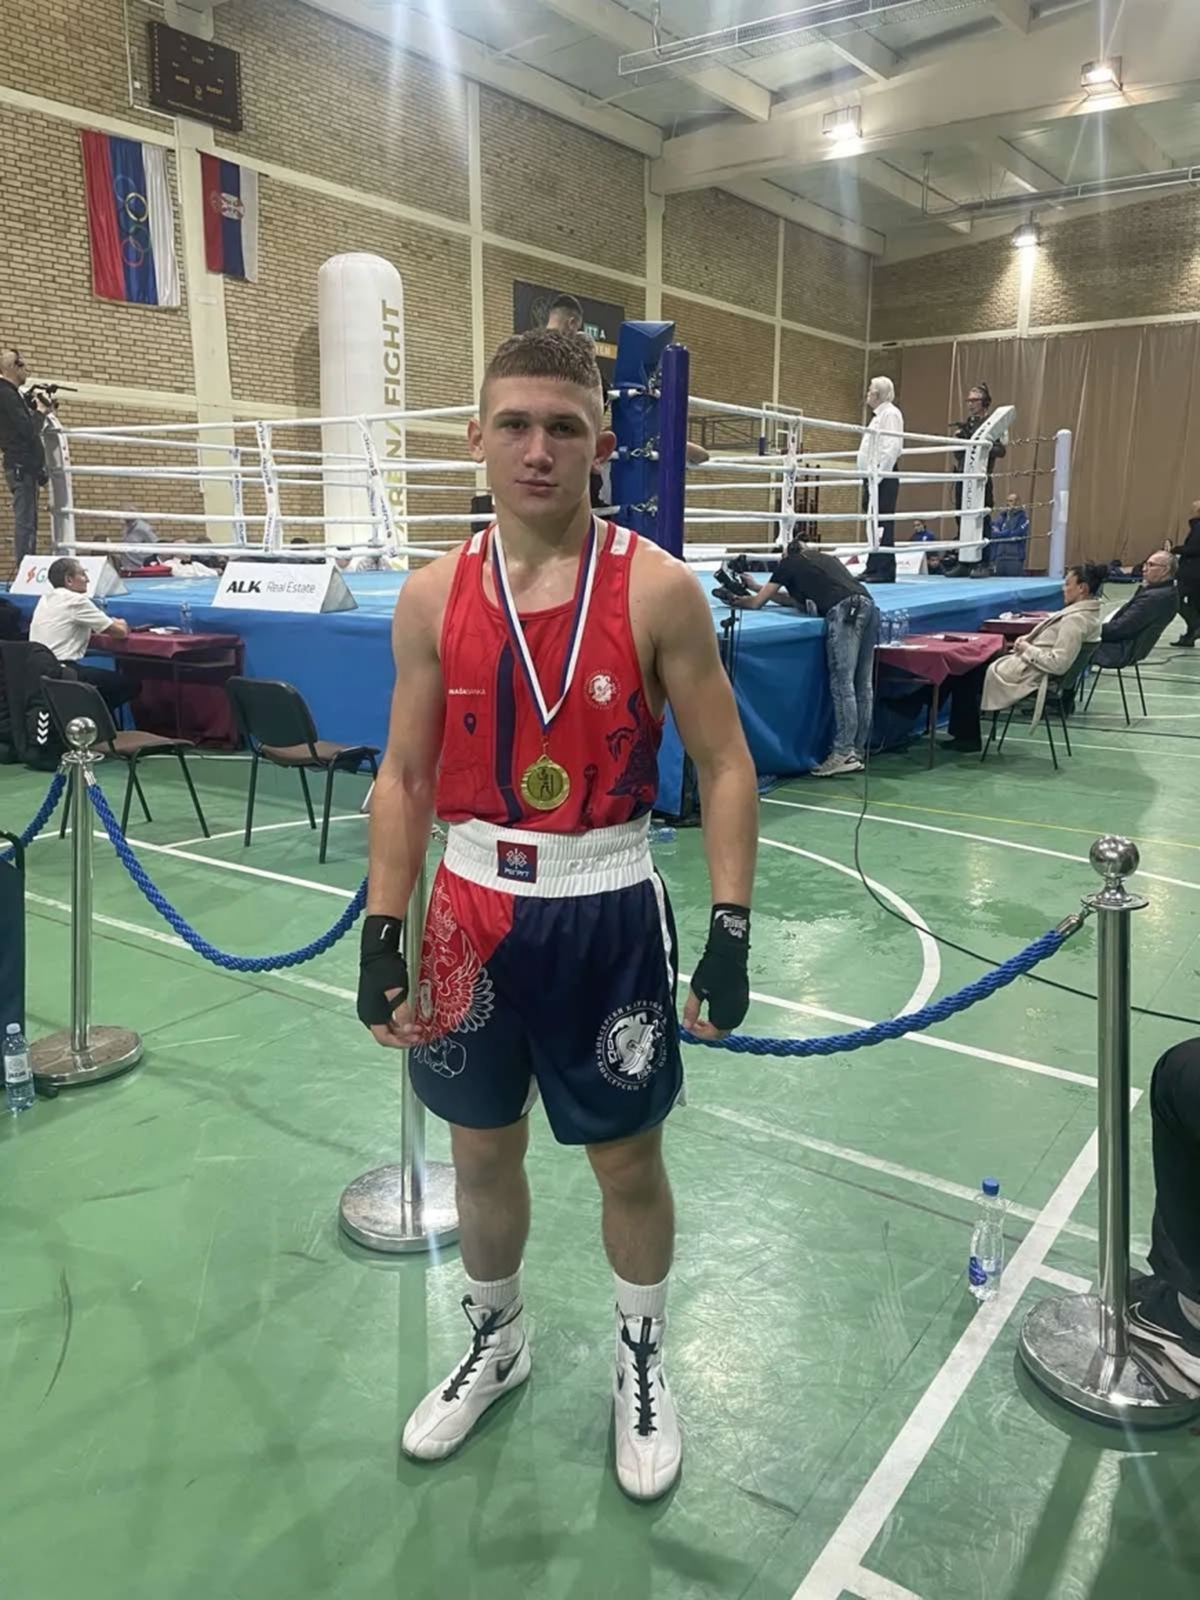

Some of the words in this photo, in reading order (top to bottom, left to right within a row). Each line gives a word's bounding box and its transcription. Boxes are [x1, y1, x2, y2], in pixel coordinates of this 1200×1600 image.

[382, 299, 401, 406] FIGHT
[226, 581, 262, 593] ALK
[266, 581, 285, 593] Real
[286, 581, 316, 594] Estate
